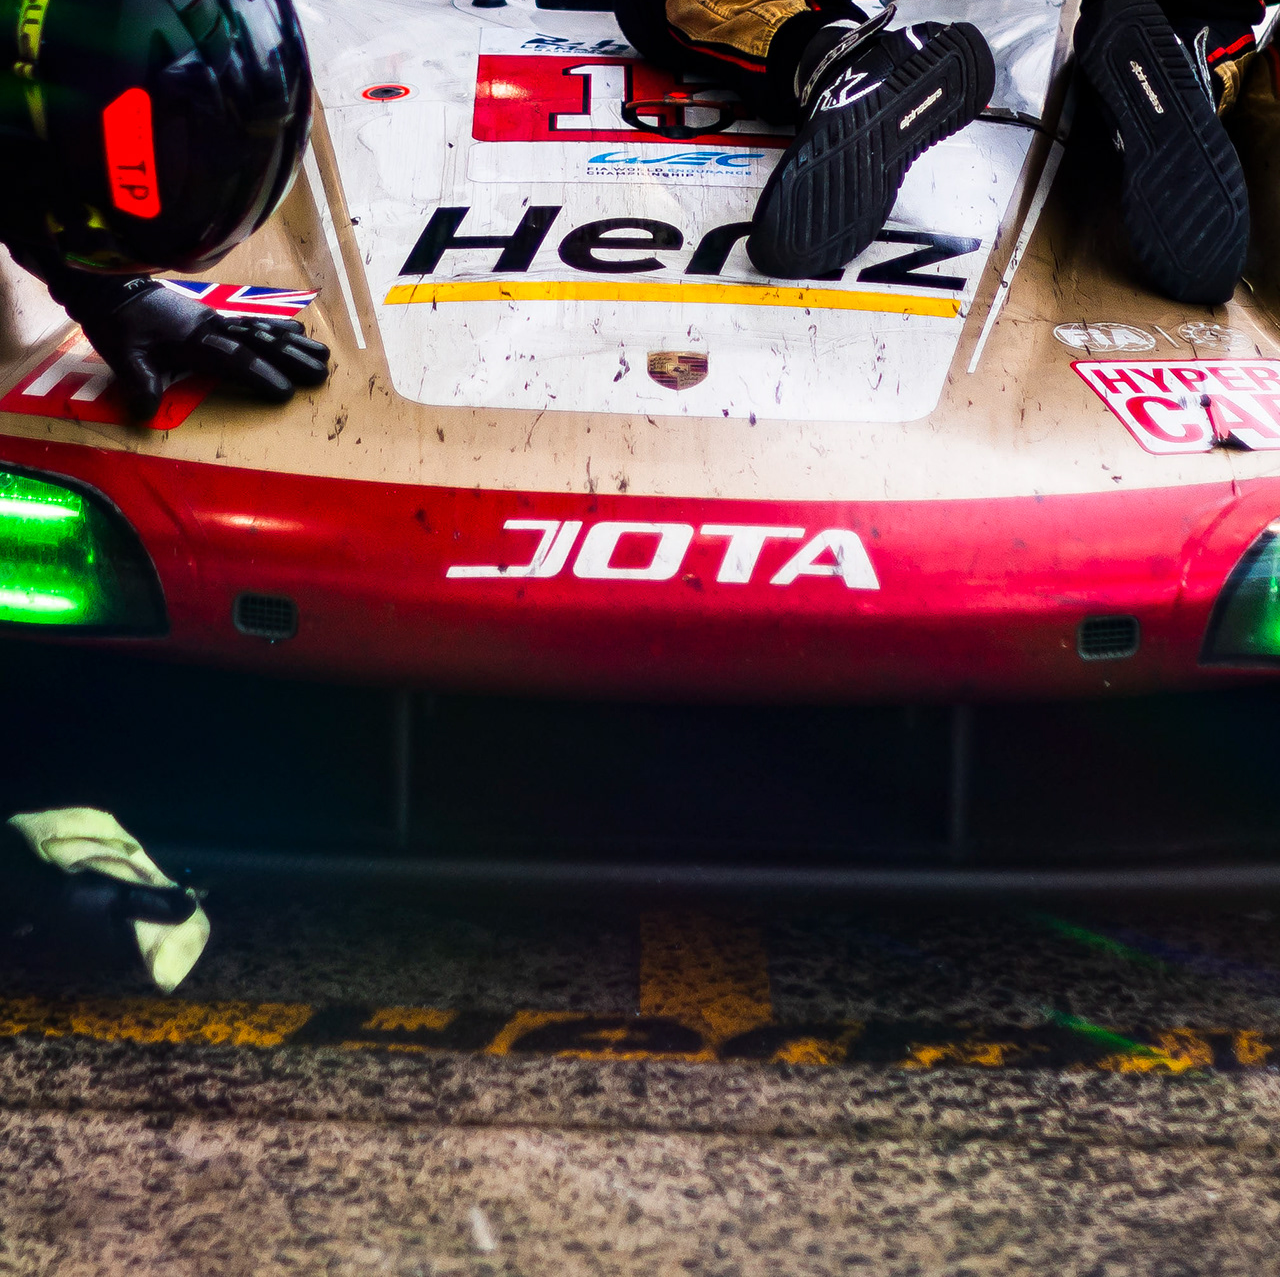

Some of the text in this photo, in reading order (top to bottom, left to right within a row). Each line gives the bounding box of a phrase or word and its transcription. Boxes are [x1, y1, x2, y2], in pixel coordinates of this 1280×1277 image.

[397, 204, 983, 291] Herz
[1061, 327, 1145, 348] FIA
[445, 519, 881, 590] JOTA
